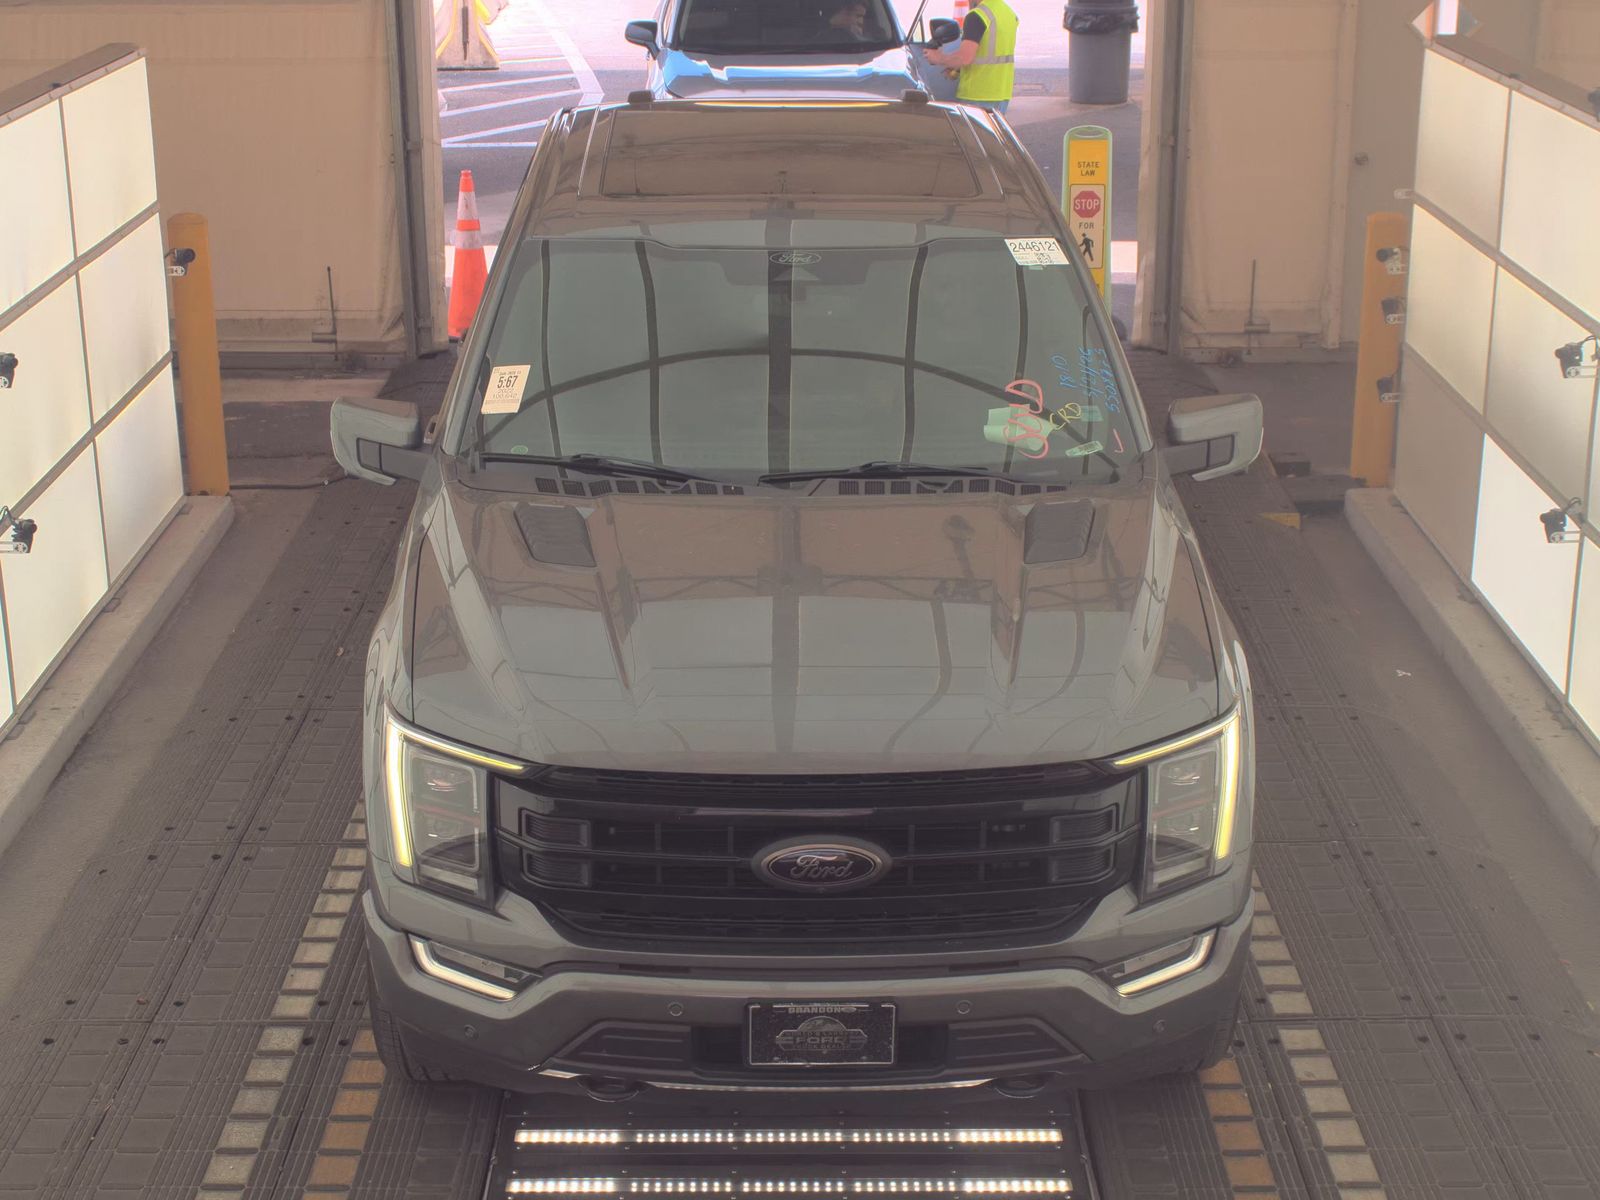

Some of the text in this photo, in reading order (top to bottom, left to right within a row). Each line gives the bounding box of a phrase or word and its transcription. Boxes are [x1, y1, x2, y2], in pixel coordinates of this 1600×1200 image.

[1077, 161, 1101, 169] STATE
[1074, 199, 1100, 210] STOP
[1078, 222, 1095, 230] FOR
[1009, 241, 1061, 253] 2446121
[790, 854, 854, 879] Ford
[787, 1006, 842, 1015] BRANDON
